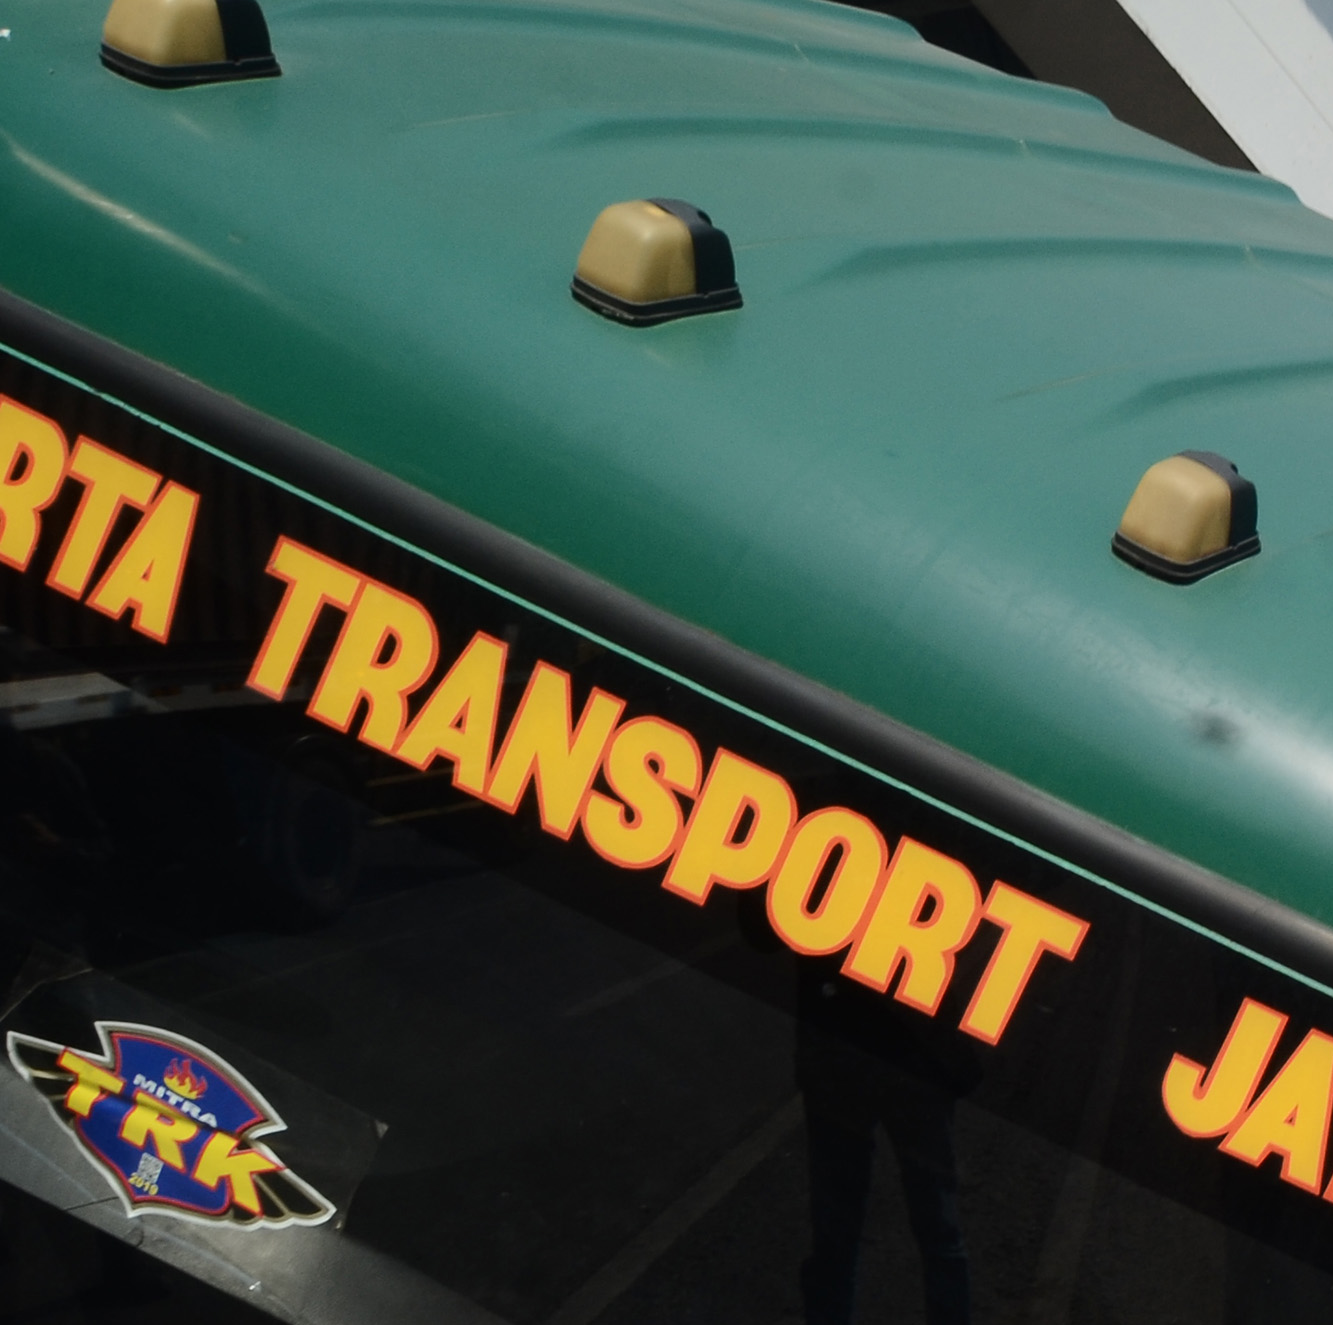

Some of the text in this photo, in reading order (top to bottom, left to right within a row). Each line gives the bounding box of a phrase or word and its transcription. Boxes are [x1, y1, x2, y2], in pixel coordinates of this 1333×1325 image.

[0, 393, 200, 645] RTA
[245, 534, 1091, 1046] TRANSPORT
[57, 1046, 288, 1219] TRK
[133, 1073, 218, 1129] MITRA
